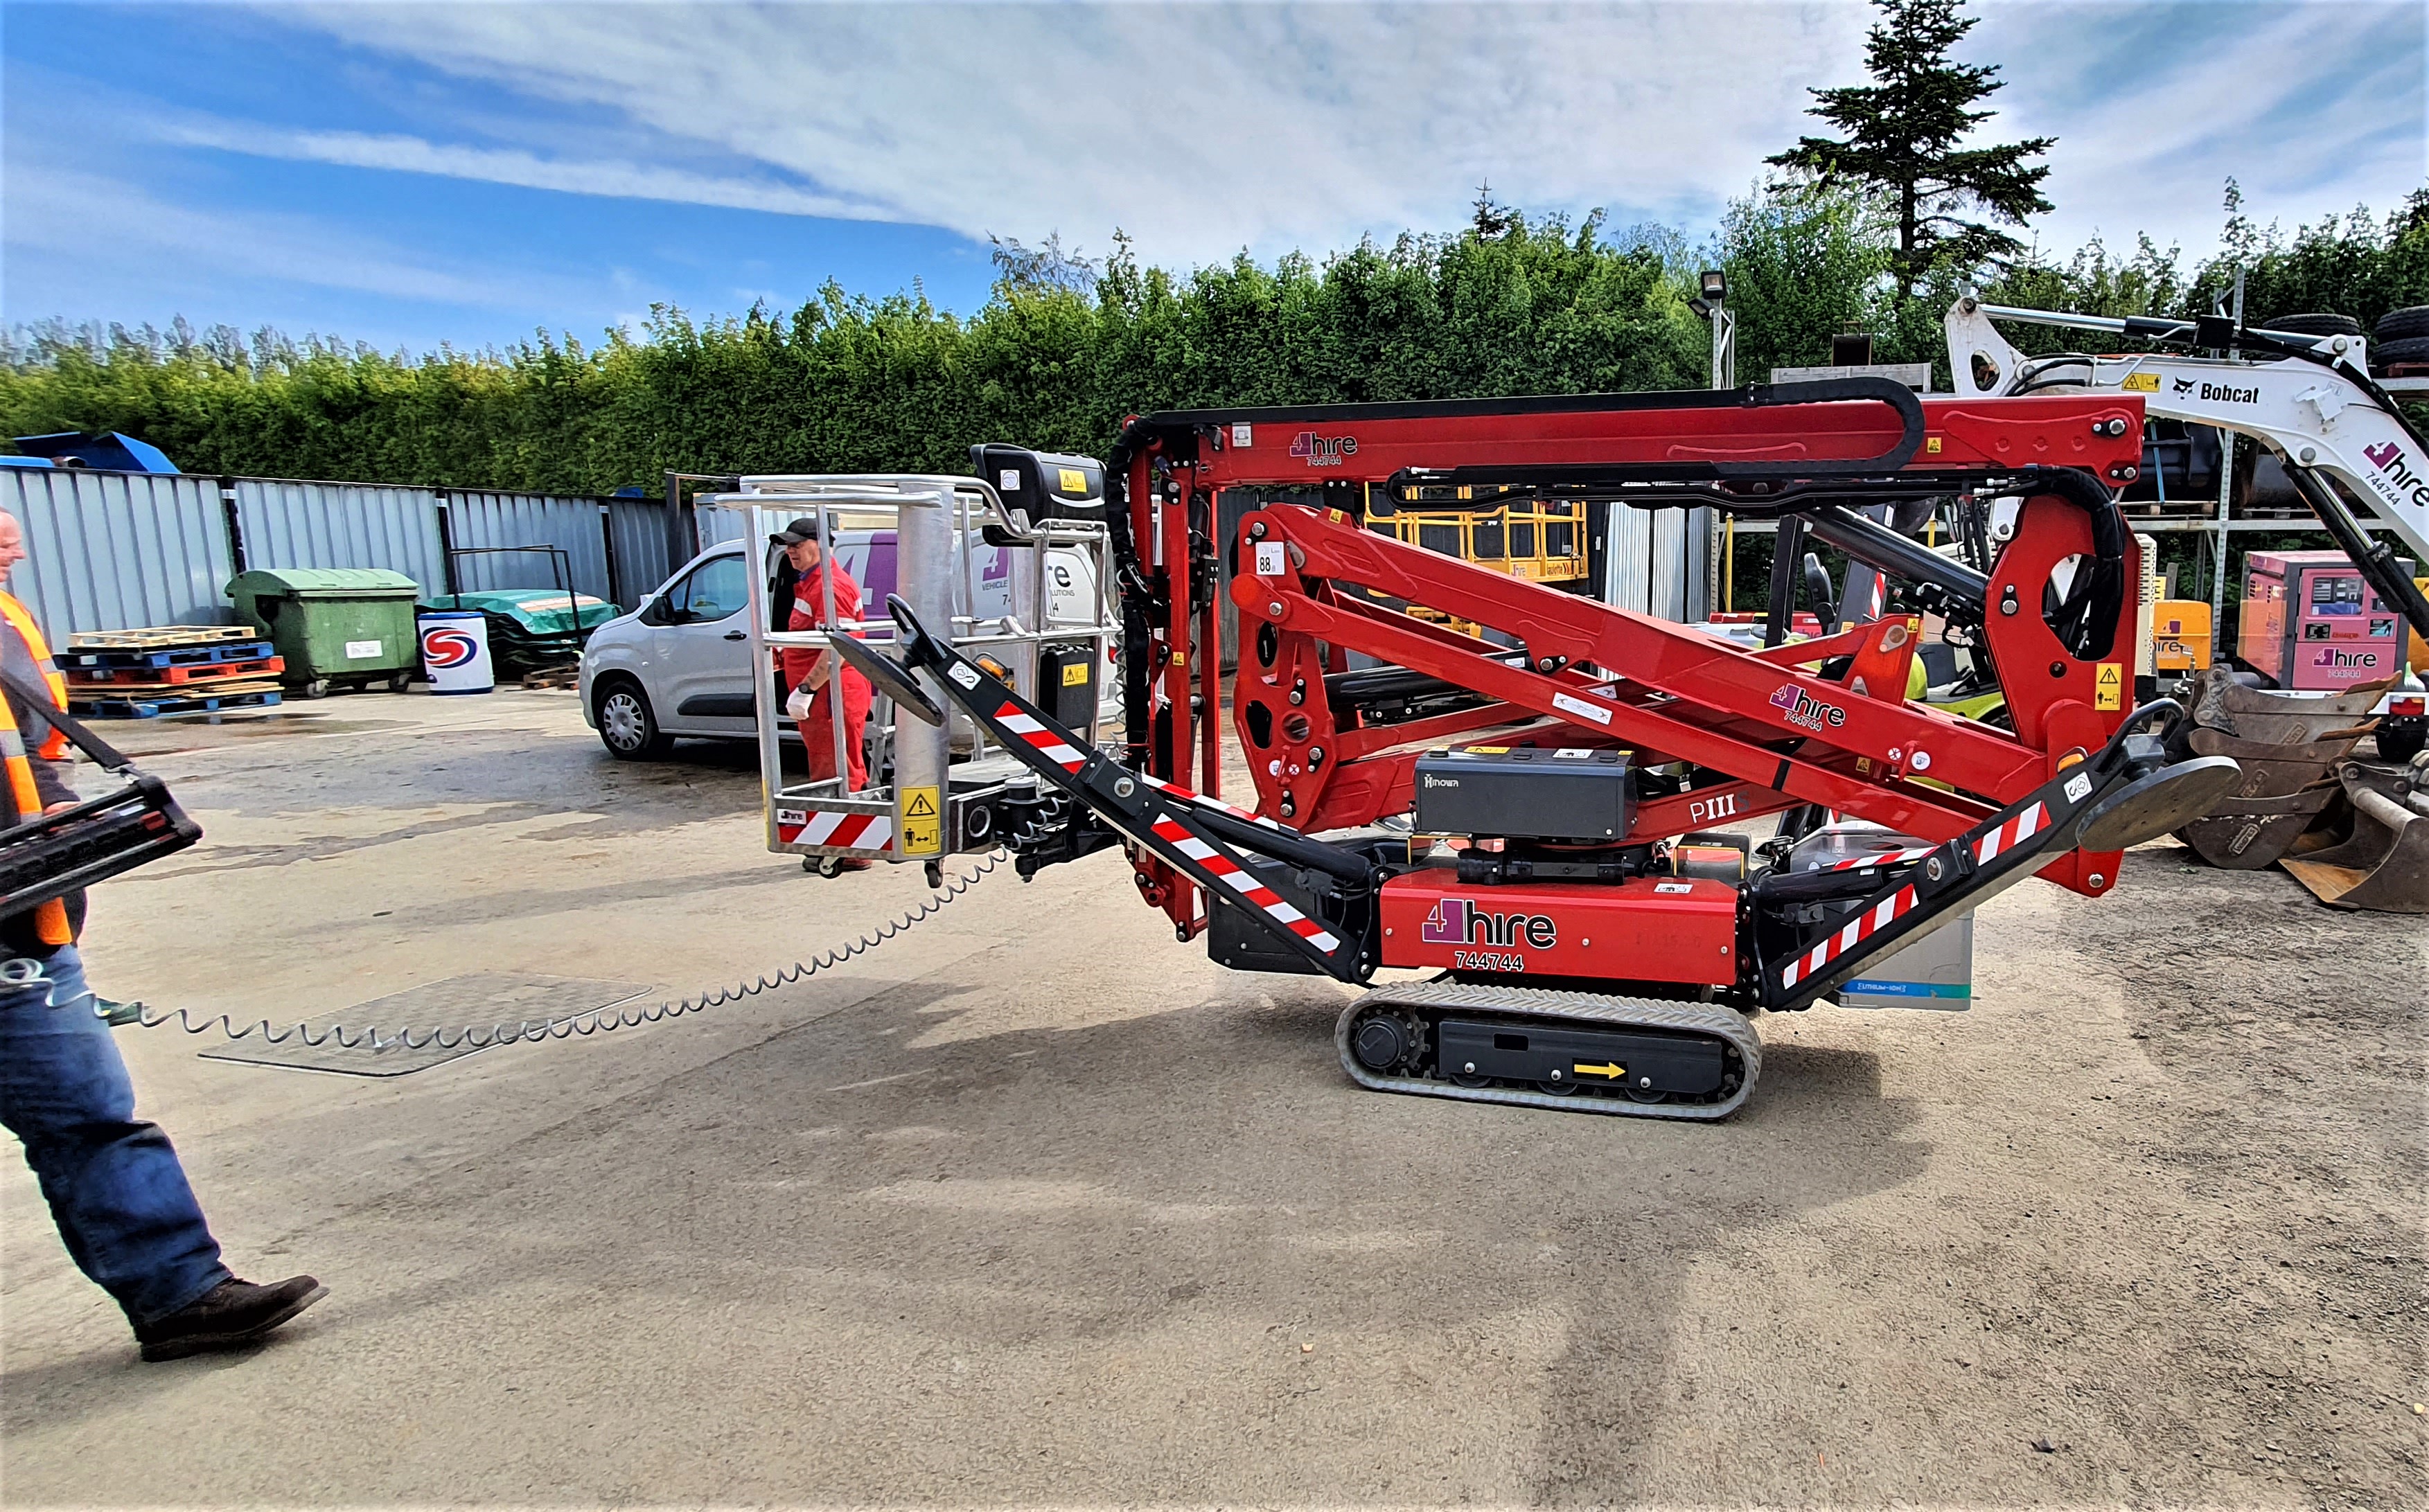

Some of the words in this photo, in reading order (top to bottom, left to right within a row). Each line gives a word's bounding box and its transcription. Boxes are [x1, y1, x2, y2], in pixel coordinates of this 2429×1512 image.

[2200, 383, 2259, 404] Bobcat
[1306, 455, 1342, 466] 744744
[2365, 470, 2401, 506] 744744
[1260, 556, 1271, 572] 88
[982, 580, 1008, 591] VEHICLE
[1784, 711, 1823, 731] 744744
[1455, 951, 1524, 972] 744744
